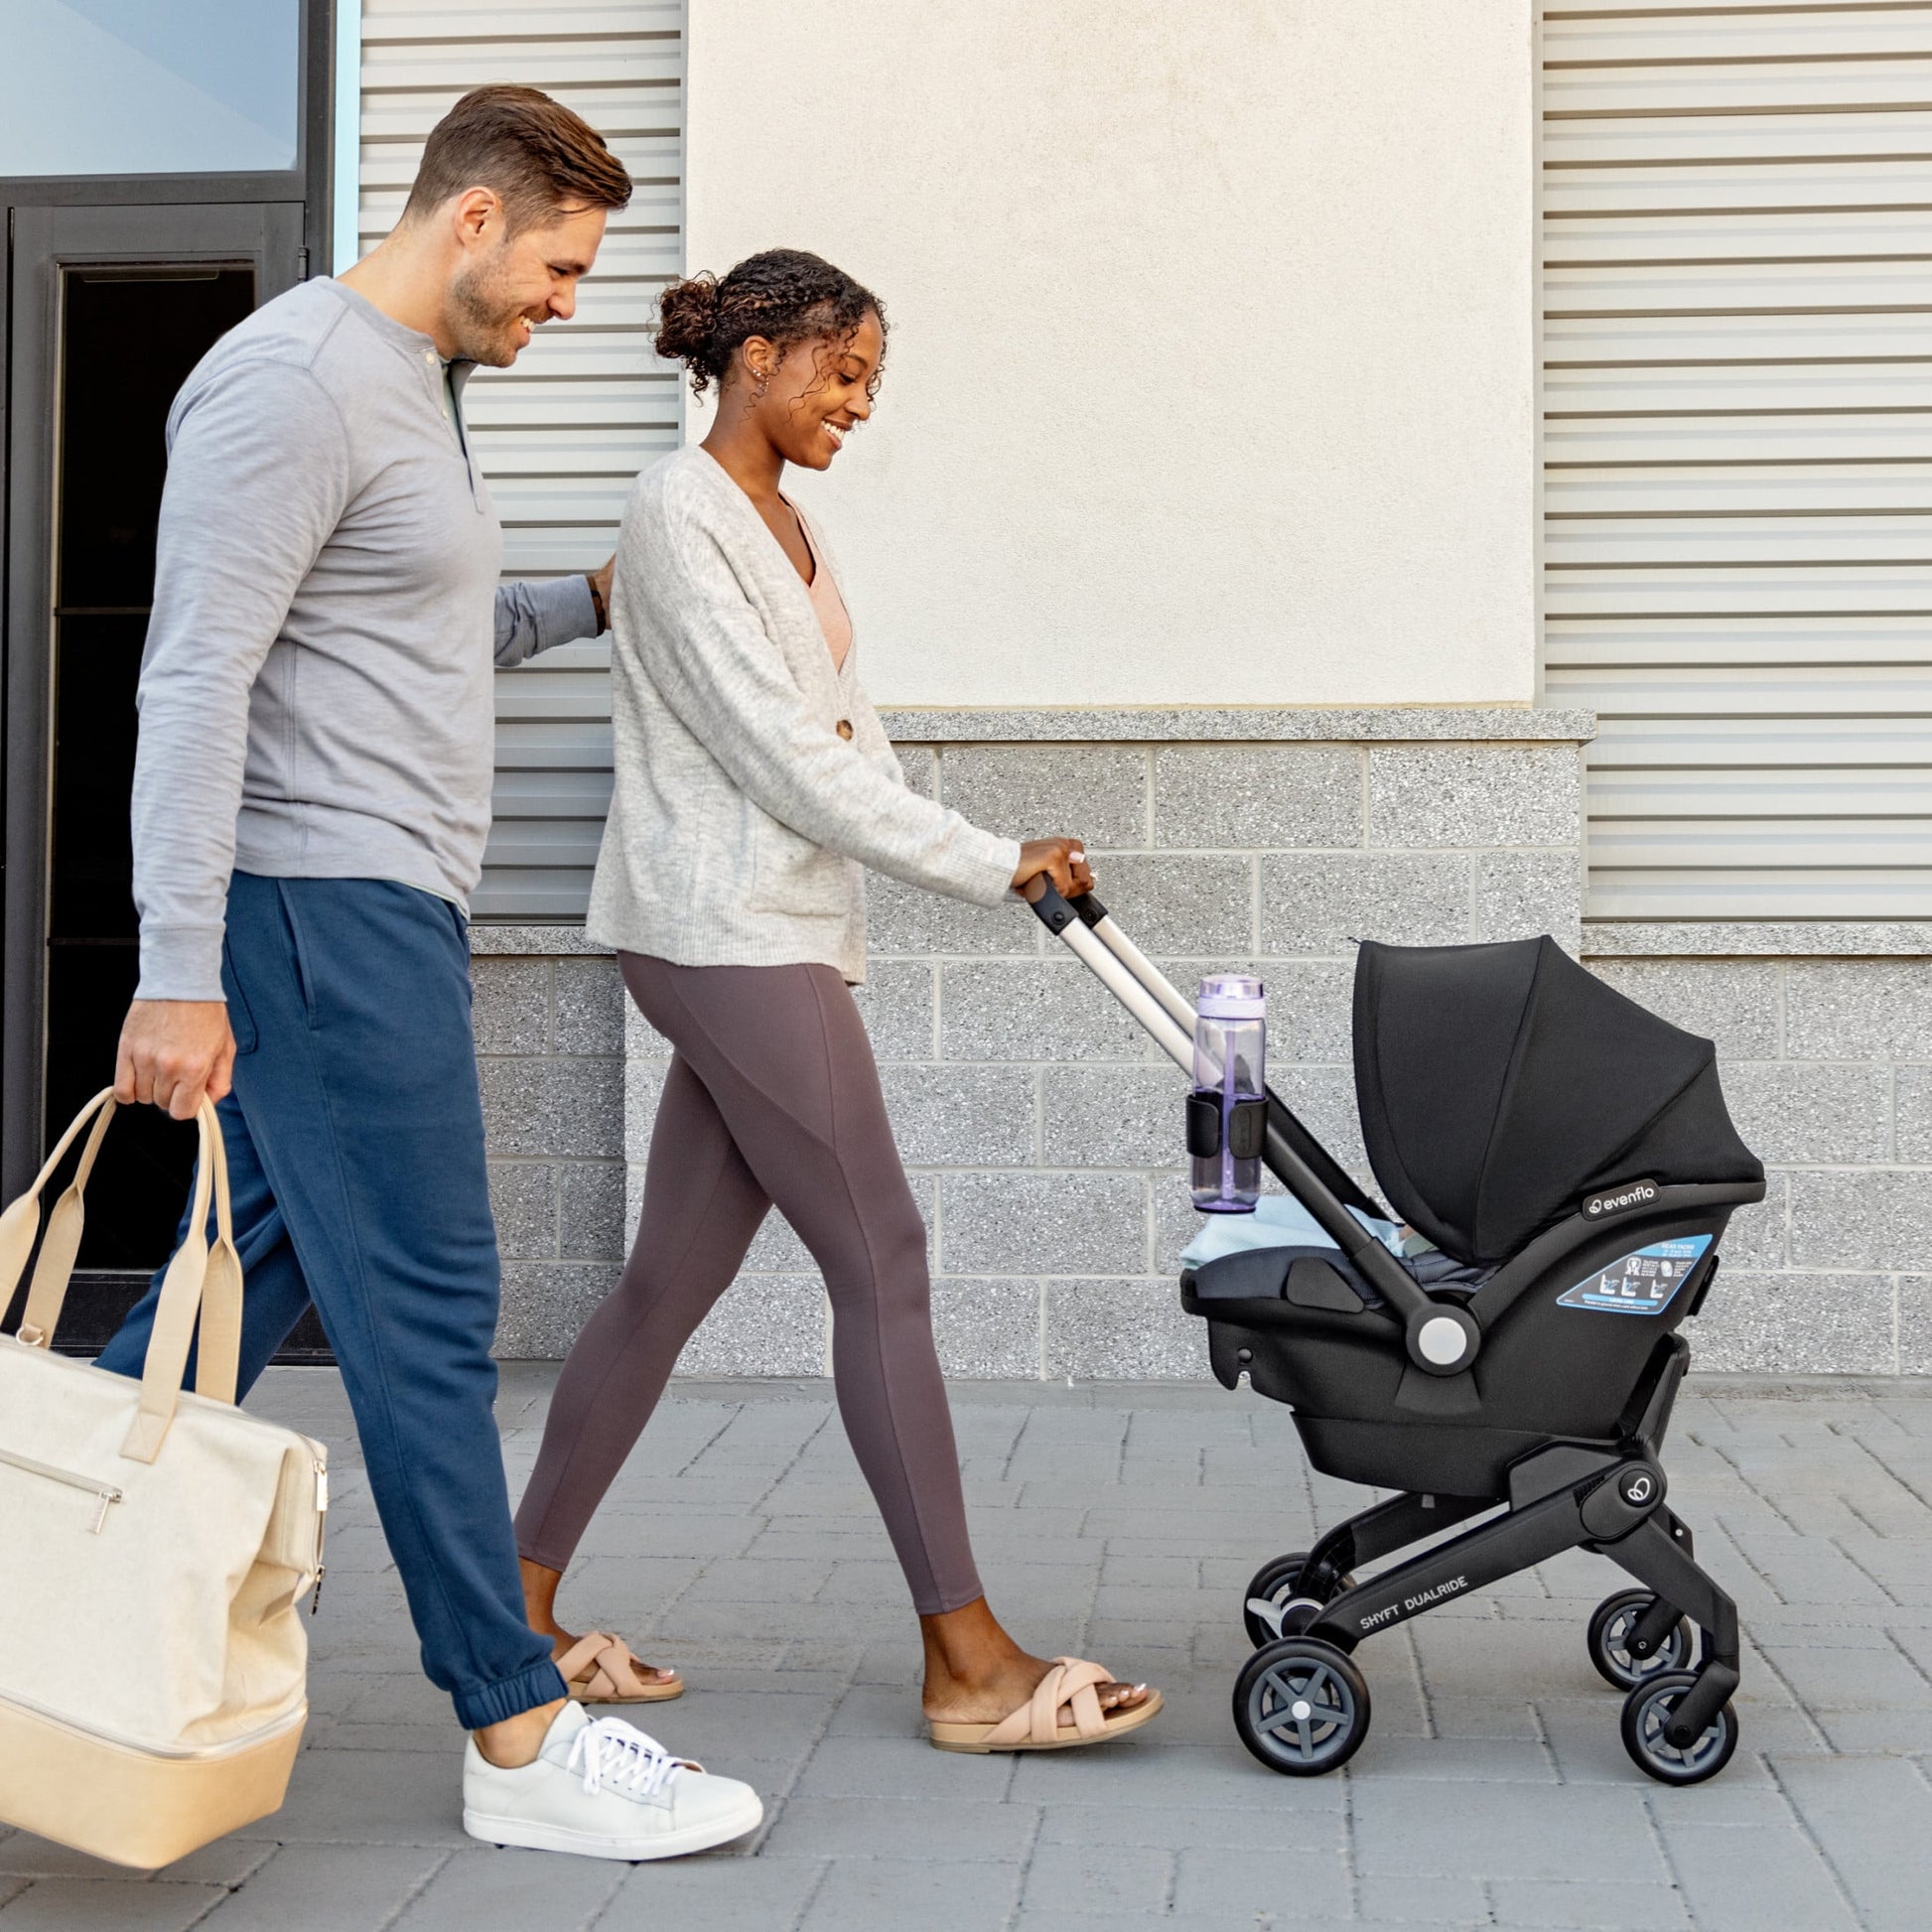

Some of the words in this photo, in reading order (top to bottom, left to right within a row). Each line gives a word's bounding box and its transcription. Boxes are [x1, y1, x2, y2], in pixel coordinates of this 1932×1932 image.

[1603, 1186, 1654, 1210] evenflo
[1360, 1604, 1398, 1629] SHYFT
[1405, 1576, 1467, 1610] DUALRIDE
